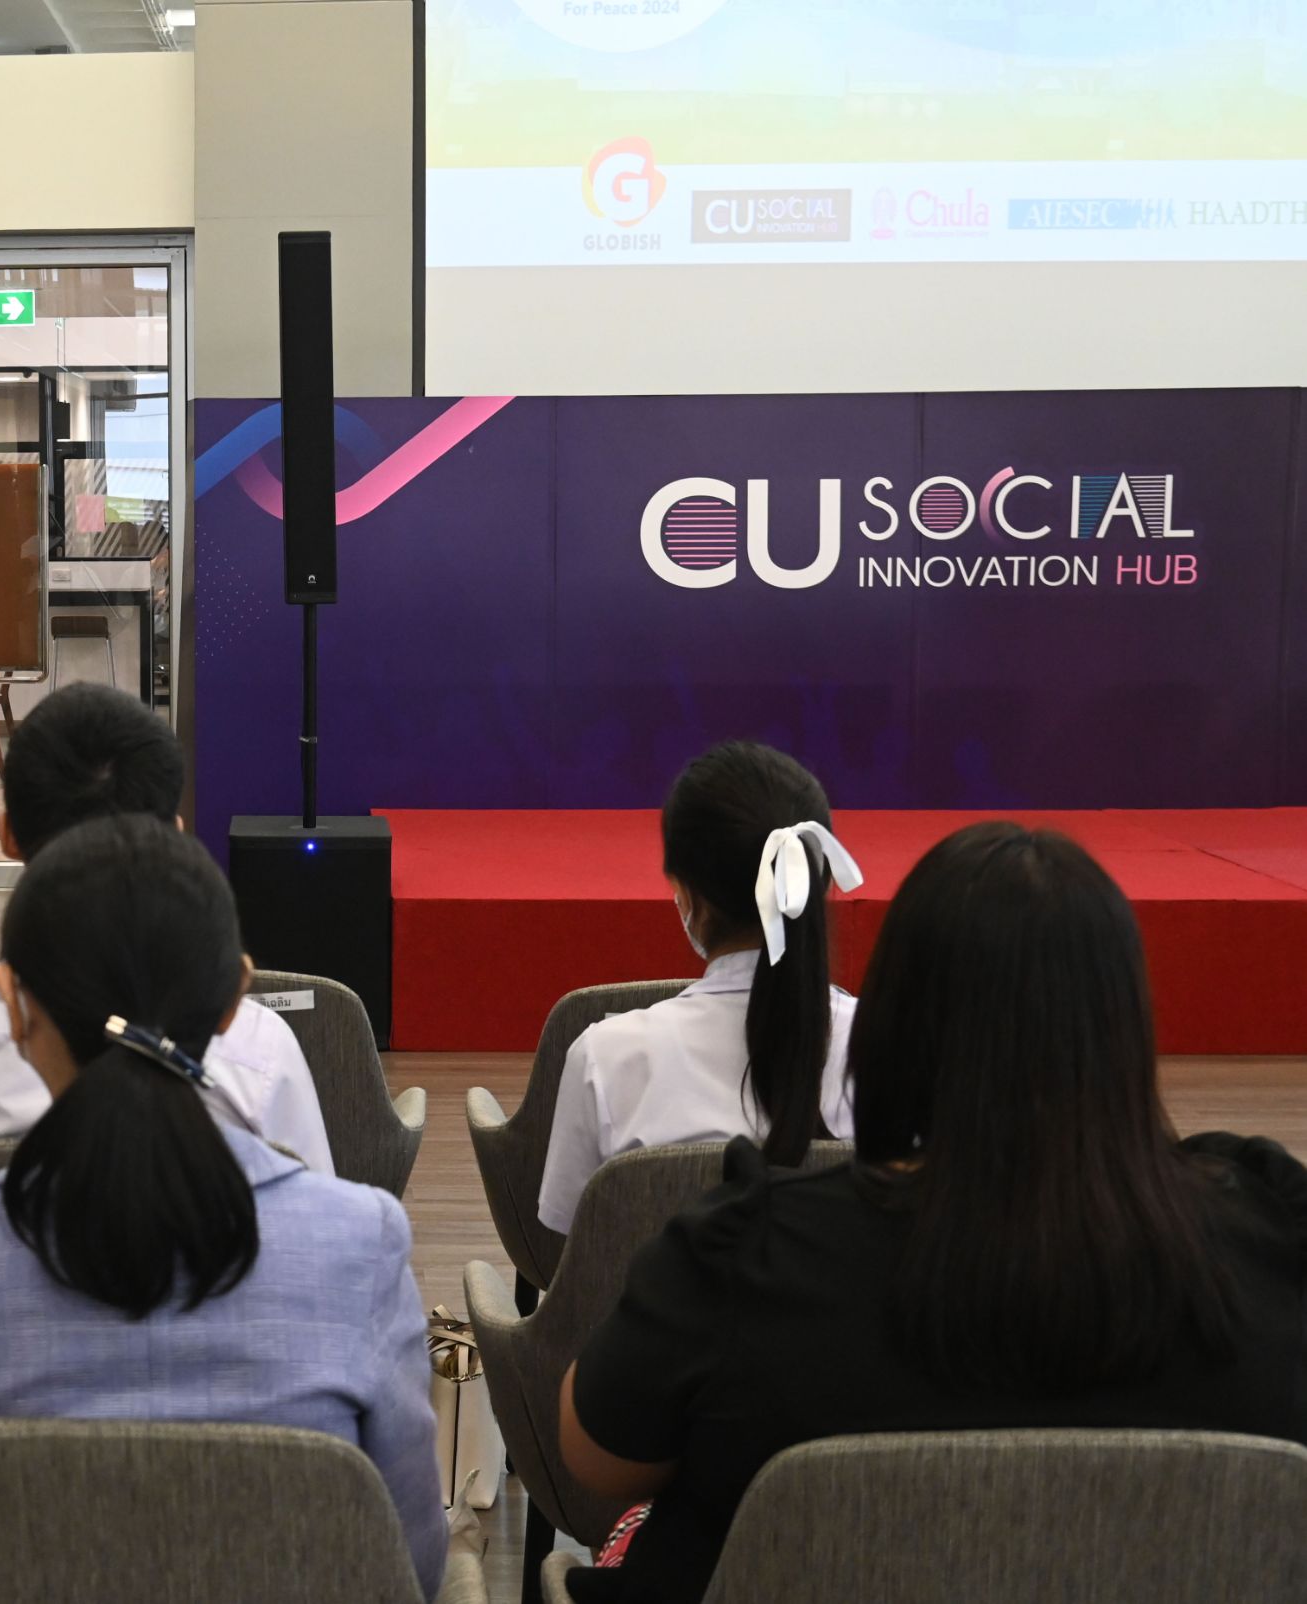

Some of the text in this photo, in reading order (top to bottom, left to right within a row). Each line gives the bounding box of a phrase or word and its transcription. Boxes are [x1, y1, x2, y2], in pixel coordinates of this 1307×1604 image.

[563, 0, 680, 16] For Peace 2024
[704, 196, 837, 235] CU SOCIAL
[905, 188, 990, 227] Chula
[1023, 200, 1119, 228] AIESEC
[1187, 200, 1307, 225] HAADTH
[583, 233, 662, 251] GLOBISH
[640, 467, 1195, 589] CU SOCIAL
[858, 554, 1198, 588] INNOVATION HUB
